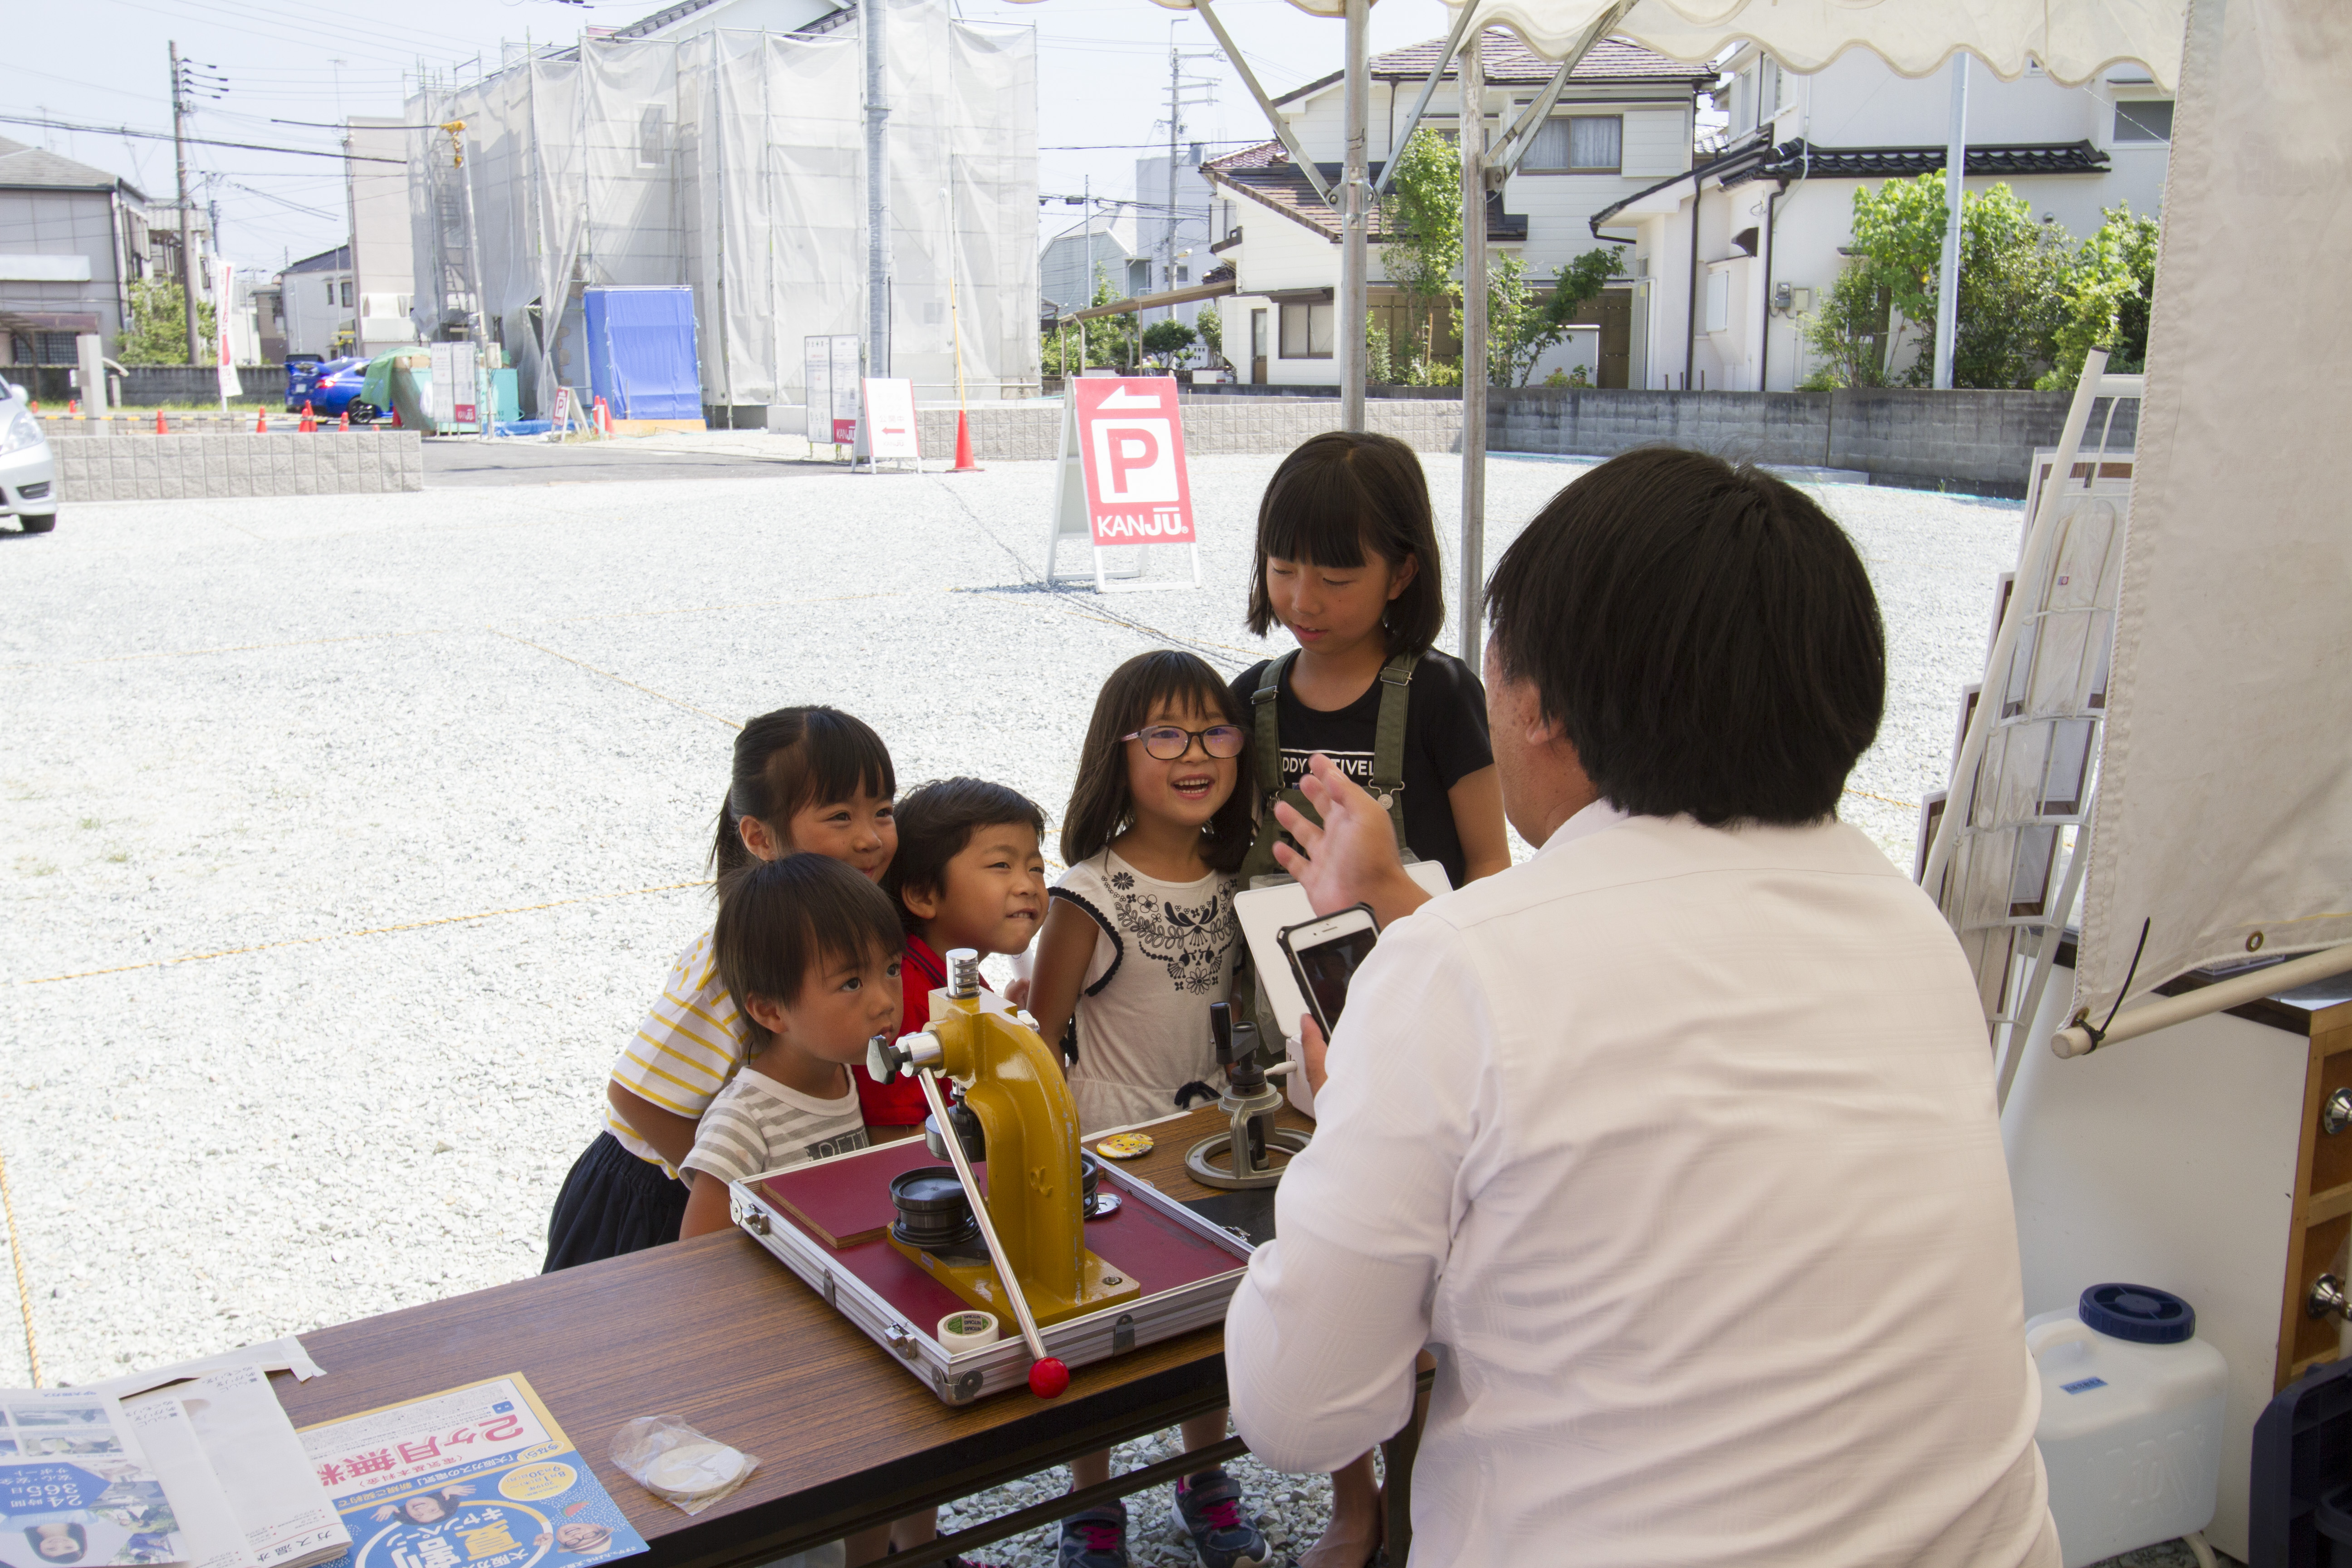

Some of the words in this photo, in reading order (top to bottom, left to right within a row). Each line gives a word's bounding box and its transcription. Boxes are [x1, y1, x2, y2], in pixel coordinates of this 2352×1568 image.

[1106, 428, 1159, 494] P
[10, 1483, 78, 1497] 365日
[10, 1494, 83, 1508] 24時間
[386, 1507, 504, 1547] キャンペーン
